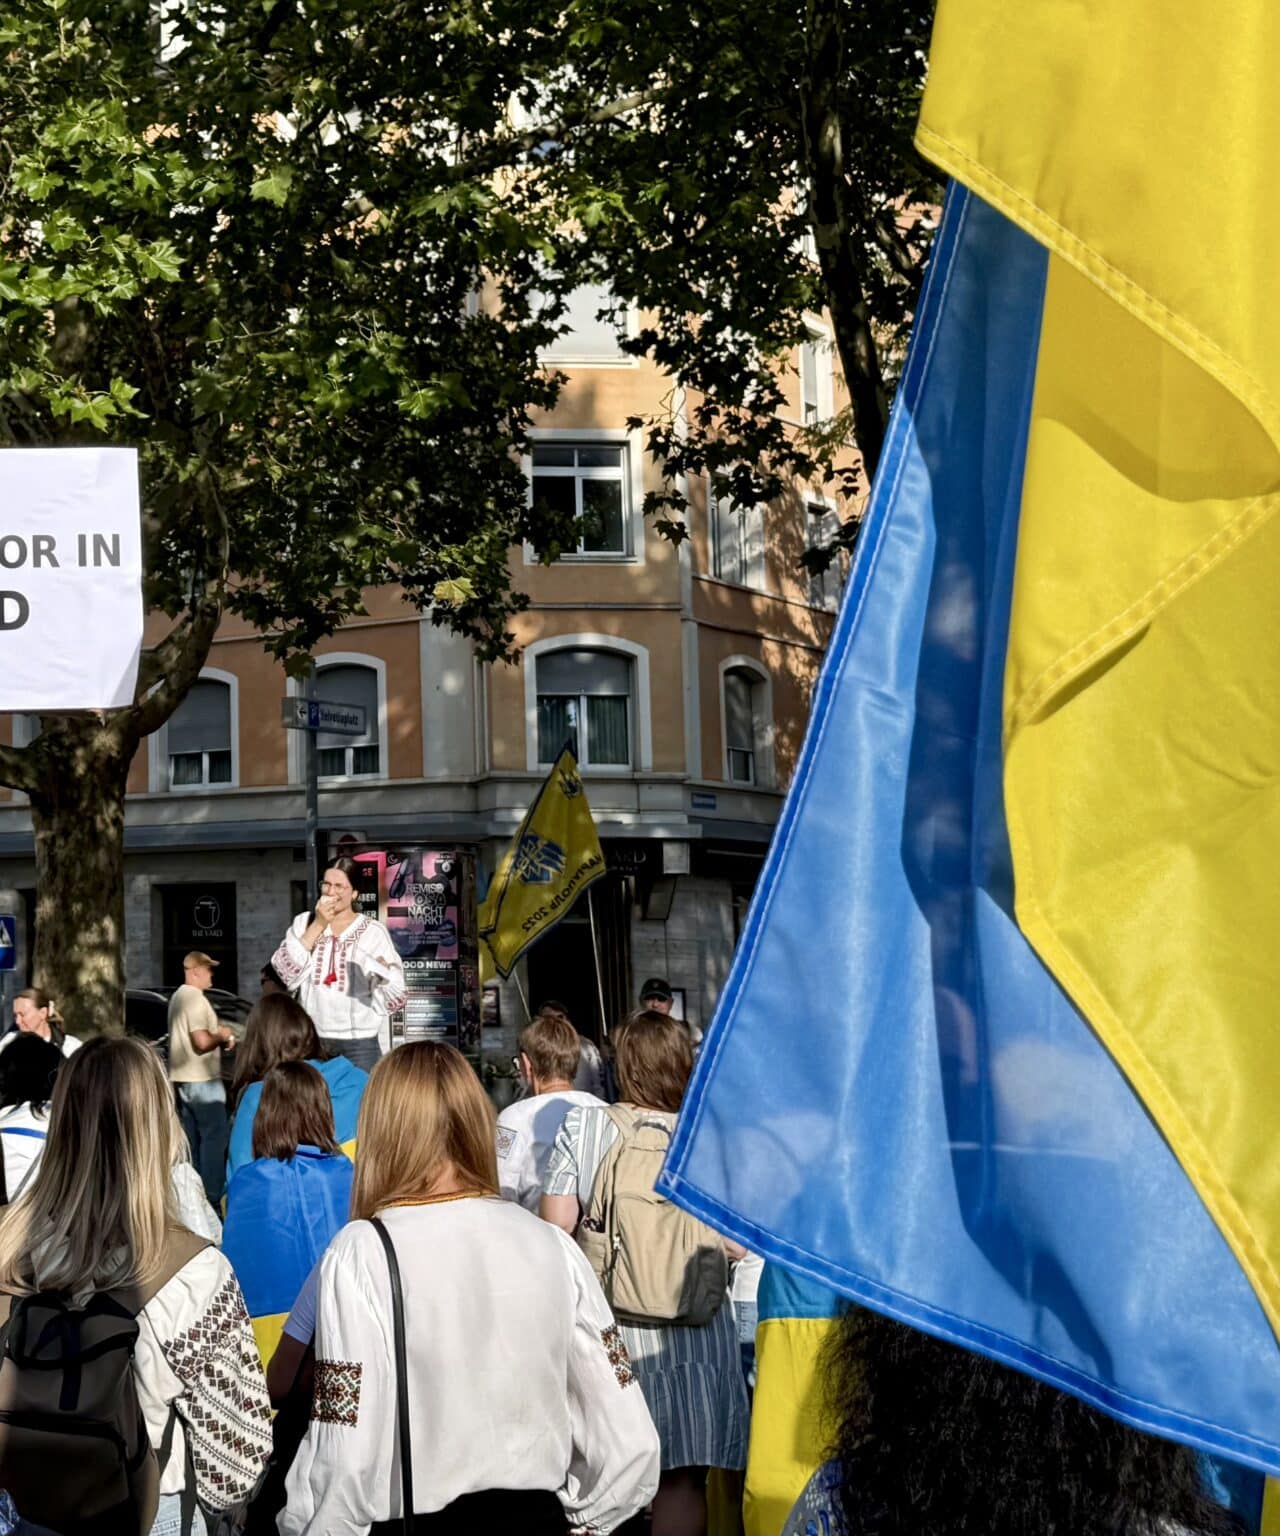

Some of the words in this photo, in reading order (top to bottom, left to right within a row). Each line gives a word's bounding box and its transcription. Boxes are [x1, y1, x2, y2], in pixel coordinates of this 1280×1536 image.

[79, 534, 121, 566] IN
[407, 905, 444, 916] NACHT
[407, 915, 444, 926] MARKT
[402, 961, 424, 969] OOD
[426, 961, 453, 969] NEWS
